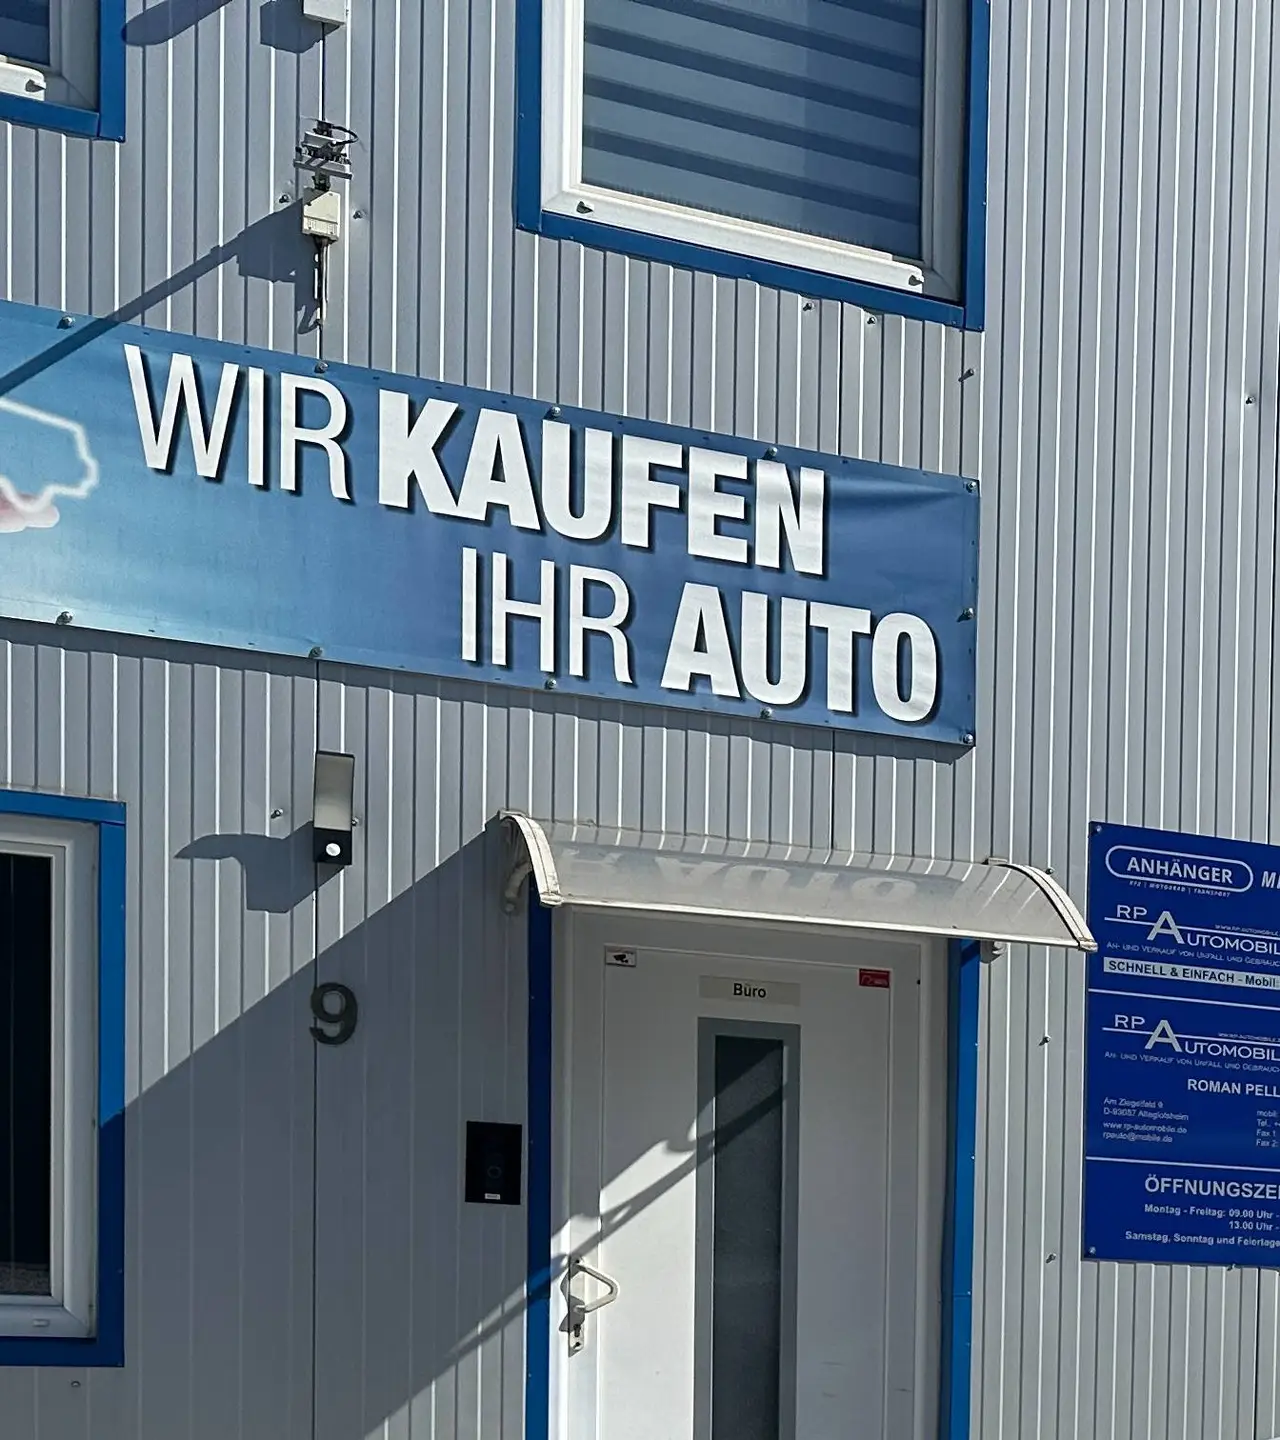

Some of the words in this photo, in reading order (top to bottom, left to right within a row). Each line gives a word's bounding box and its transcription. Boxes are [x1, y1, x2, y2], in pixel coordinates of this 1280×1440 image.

[123, 343, 352, 502] WIR
[377, 390, 826, 577] KAUFEN
[462, 547, 633, 684] IHR
[661, 582, 938, 723] AUTO
[1127, 857, 1233, 884] ANHÄNGER
[1116, 904, 1148, 920] RP
[1108, 960, 1166, 976] SCHNELL
[1170, 967, 1178, 977] &
[1183, 968, 1235, 984] EINFACH
[732, 982, 767, 1000] Büro
[309, 982, 359, 1046] 9
[1114, 1014, 1145, 1030] RP
[1187, 1079, 1241, 1095] ROMAN
[1144, 1204, 1181, 1217] Montag
[1189, 1206, 1226, 1219] Freitag:
[1229, 1209, 1254, 1219] 09.00
[1256, 1209, 1273, 1220] Uhr
[1229, 1220, 1254, 1231] 13.00
[1256, 1221, 1273, 1232] Uhr
[1125, 1230, 1171, 1245] Samstag,
[1173, 1232, 1215, 1246] Sonntag
[1216, 1235, 1235, 1245] und
[1237, 1236, 1280, 1249] Feiertage
